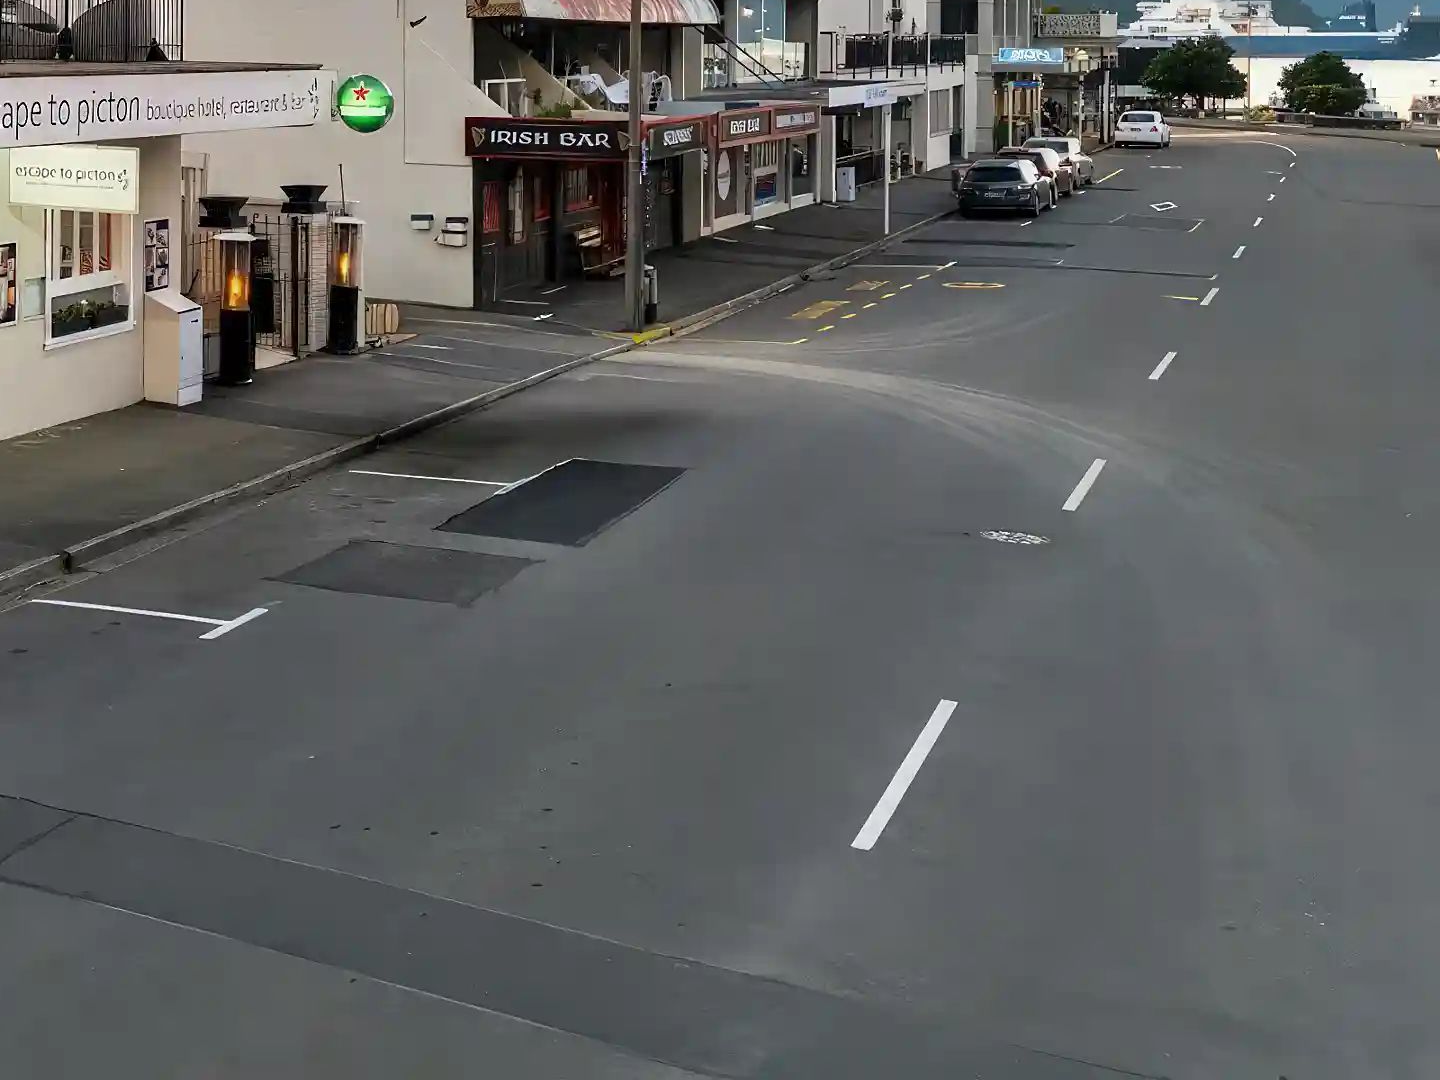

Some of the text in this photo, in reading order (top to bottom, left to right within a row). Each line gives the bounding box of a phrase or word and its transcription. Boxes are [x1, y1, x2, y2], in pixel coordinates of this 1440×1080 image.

[49, 94, 71, 126] to
[77, 90, 140, 136] picton
[490, 129, 611, 149] IRISH BAR
